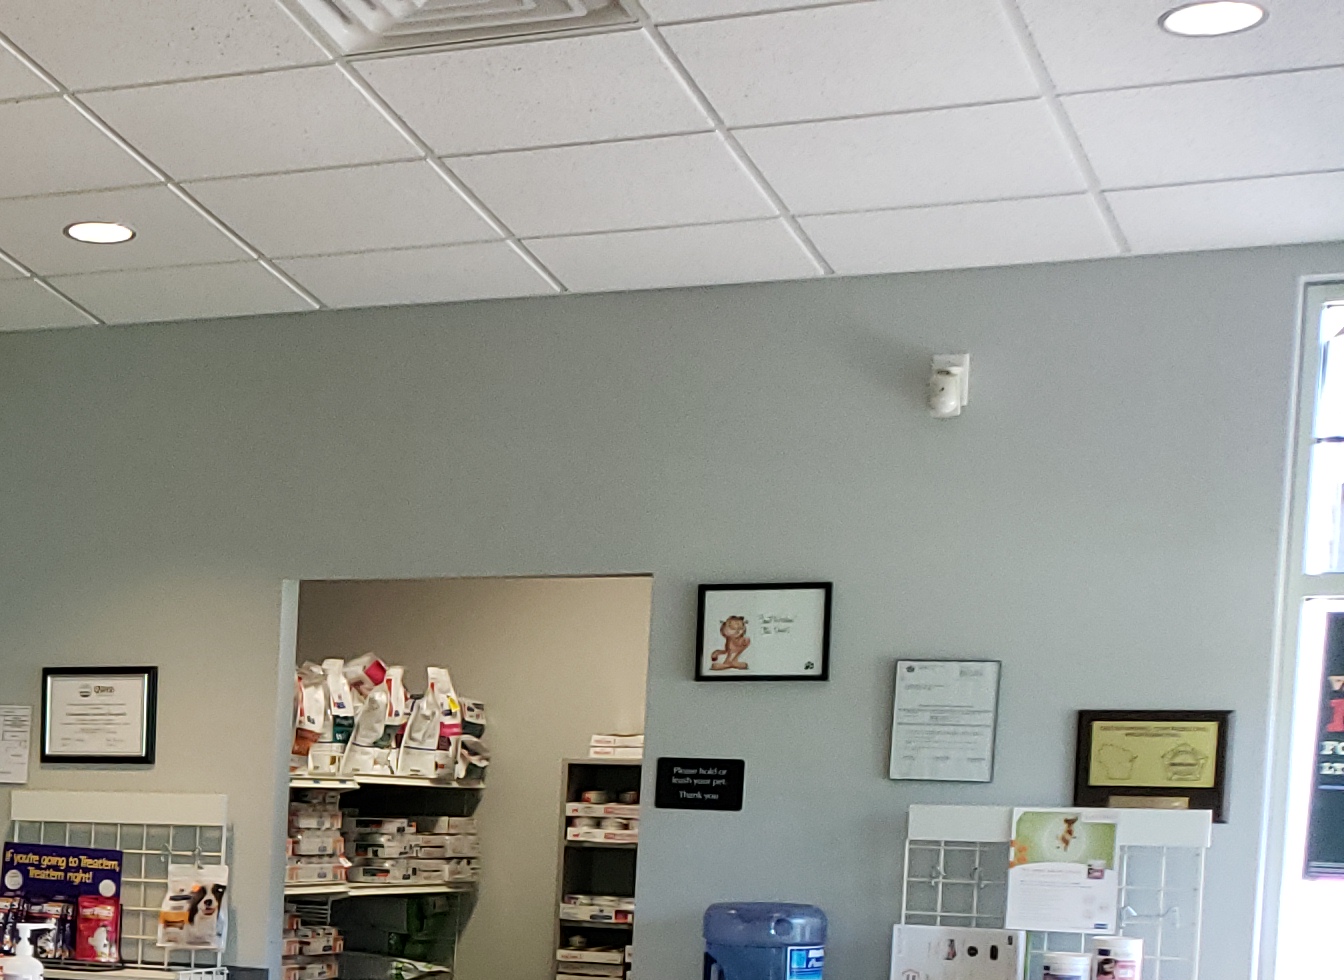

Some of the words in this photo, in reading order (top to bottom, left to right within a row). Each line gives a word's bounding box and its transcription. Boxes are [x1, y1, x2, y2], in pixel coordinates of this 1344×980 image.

[679, 790, 702, 799] Thank
[41, 854, 66, 868] going
[69, 855, 79, 864] to
[67, 870, 93, 885] right!
